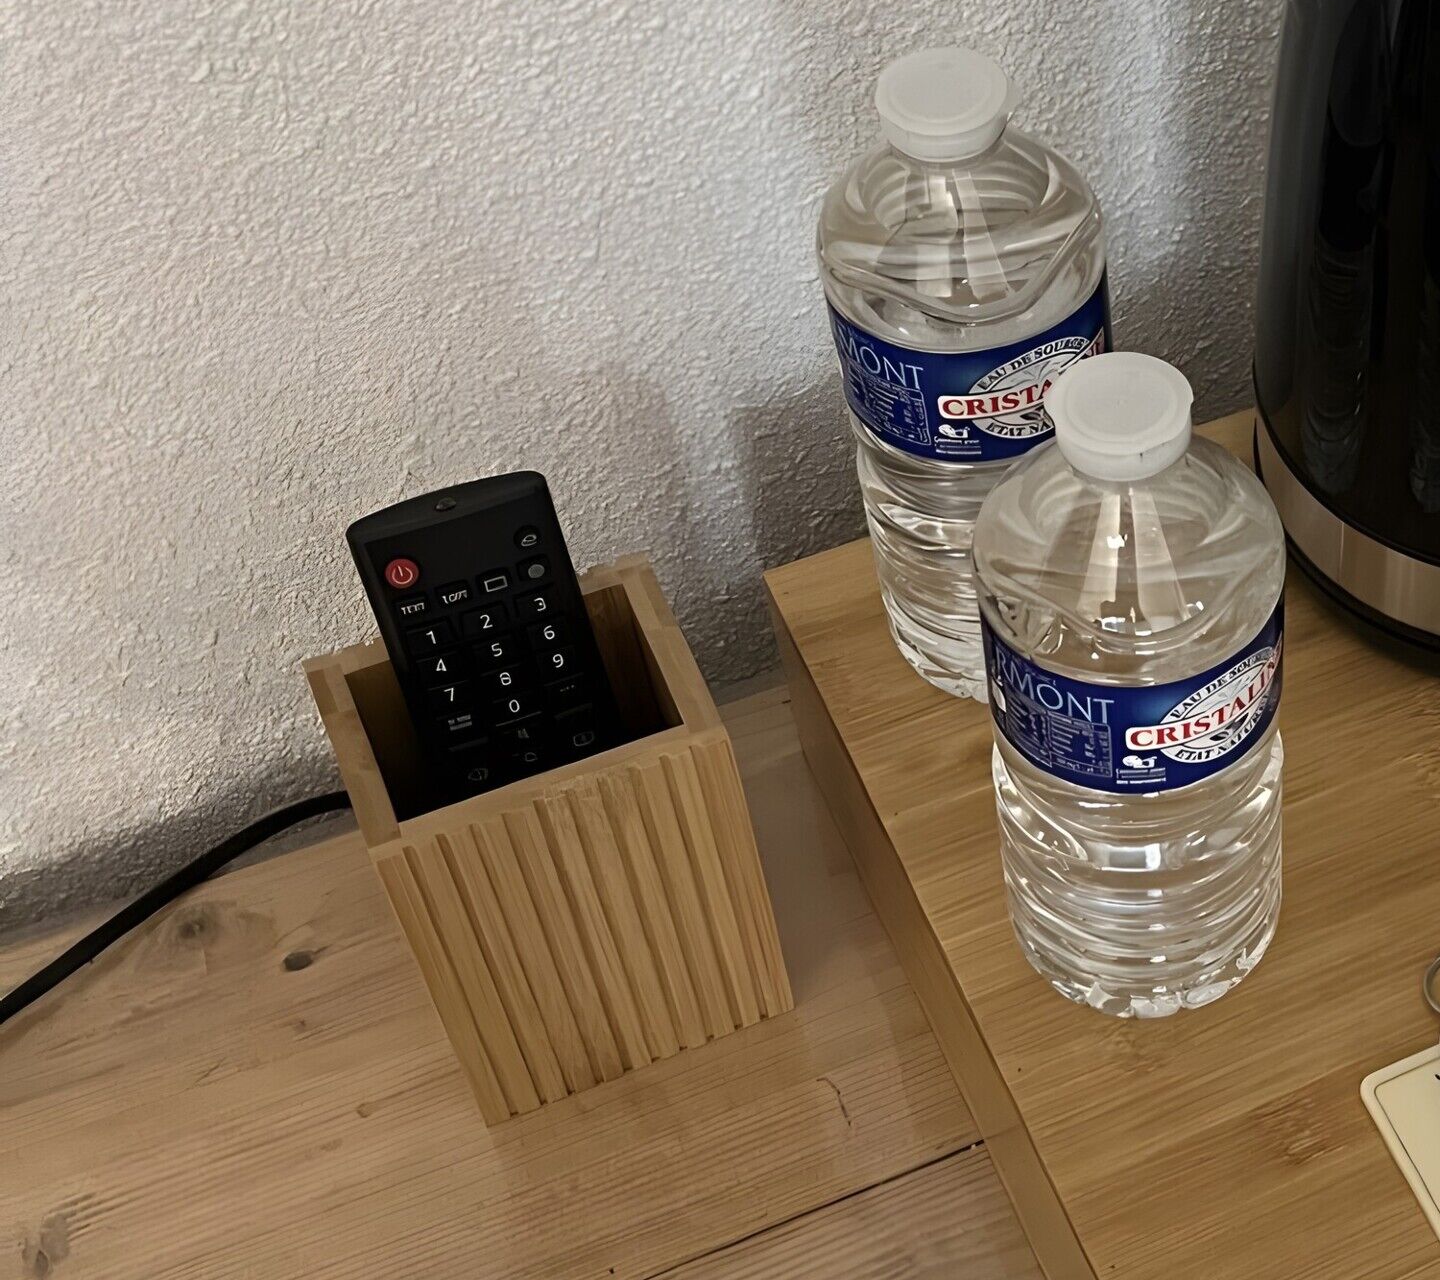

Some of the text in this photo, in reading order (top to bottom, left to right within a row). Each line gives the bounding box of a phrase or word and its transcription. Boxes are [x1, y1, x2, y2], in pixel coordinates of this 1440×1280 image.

[533, 596, 547, 612] 3
[479, 613, 493, 630] 2
[426, 630, 438, 645] 1
[543, 624, 556, 641] 6
[490, 642, 503, 658] 5
[552, 652, 565, 668] 9
[498, 671, 512, 687] 8
[443, 687, 456, 703] 7
[508, 699, 521, 714] 0
